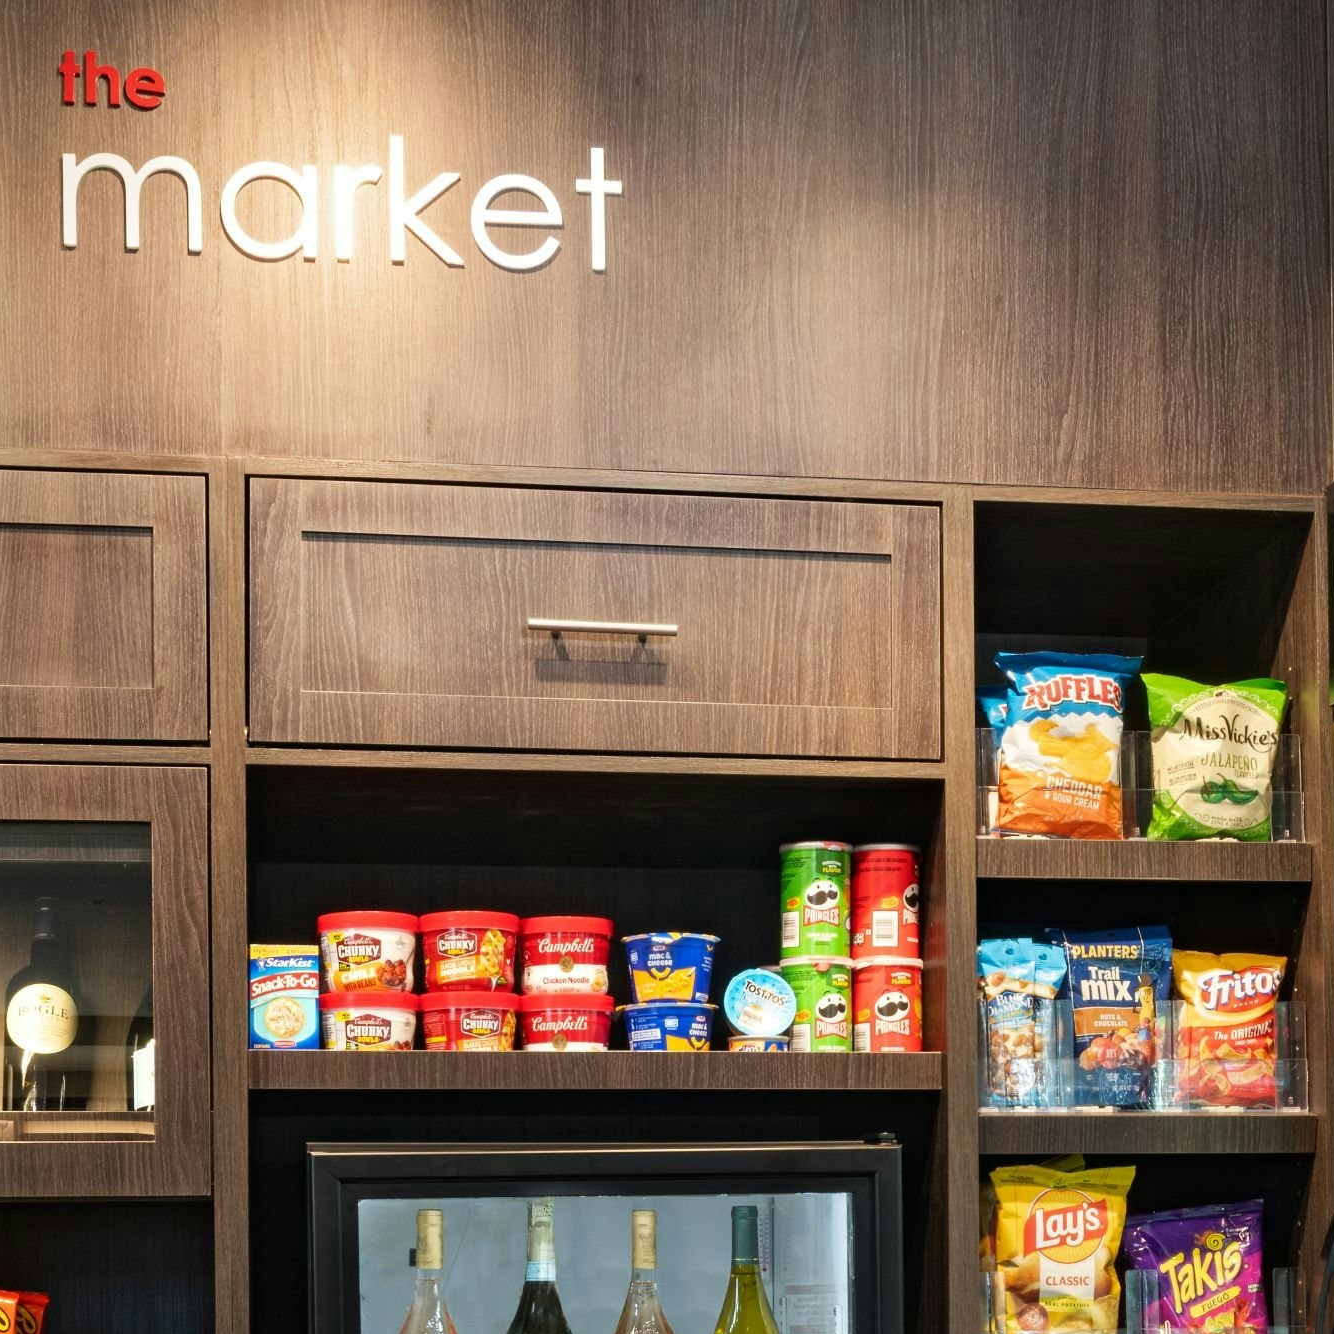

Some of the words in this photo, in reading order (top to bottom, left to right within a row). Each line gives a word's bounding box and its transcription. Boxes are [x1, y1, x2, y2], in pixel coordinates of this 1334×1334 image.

[59, 50, 166, 109] the
[61, 134, 624, 272] market
[1025, 676, 1121, 711] RUFFLES
[1046, 776, 1102, 800] CHEDDAR
[804, 908, 839, 926] PRINGLES
[337, 944, 379, 959] CHUNKY
[439, 939, 474, 952] CHUNKY
[538, 938, 594, 954] Campbell's
[1072, 945, 1139, 959] PLANTERS
[266, 957, 314, 968] StarKist
[543, 976, 566, 984] Chicken
[567, 976, 590, 984] Noodle
[1088, 967, 1120, 979] Trail
[251, 974, 317, 998] Snack-To-Go
[1081, 980, 1133, 1002] mix
[1199, 970, 1284, 1010] Fritos
[347, 1025, 389, 1037] CHUNKY
[532, 1016, 588, 1032] Campbell's
[817, 1022, 848, 1039] PRINGLES
[875, 1020, 909, 1036] PRINGLES
[1035, 1201, 1104, 1248] Lay's
[1045, 1275, 1090, 1286] CLASSIC
[1160, 1241, 1248, 1314] Takis
[1201, 1293, 1229, 1312] FUEGO
